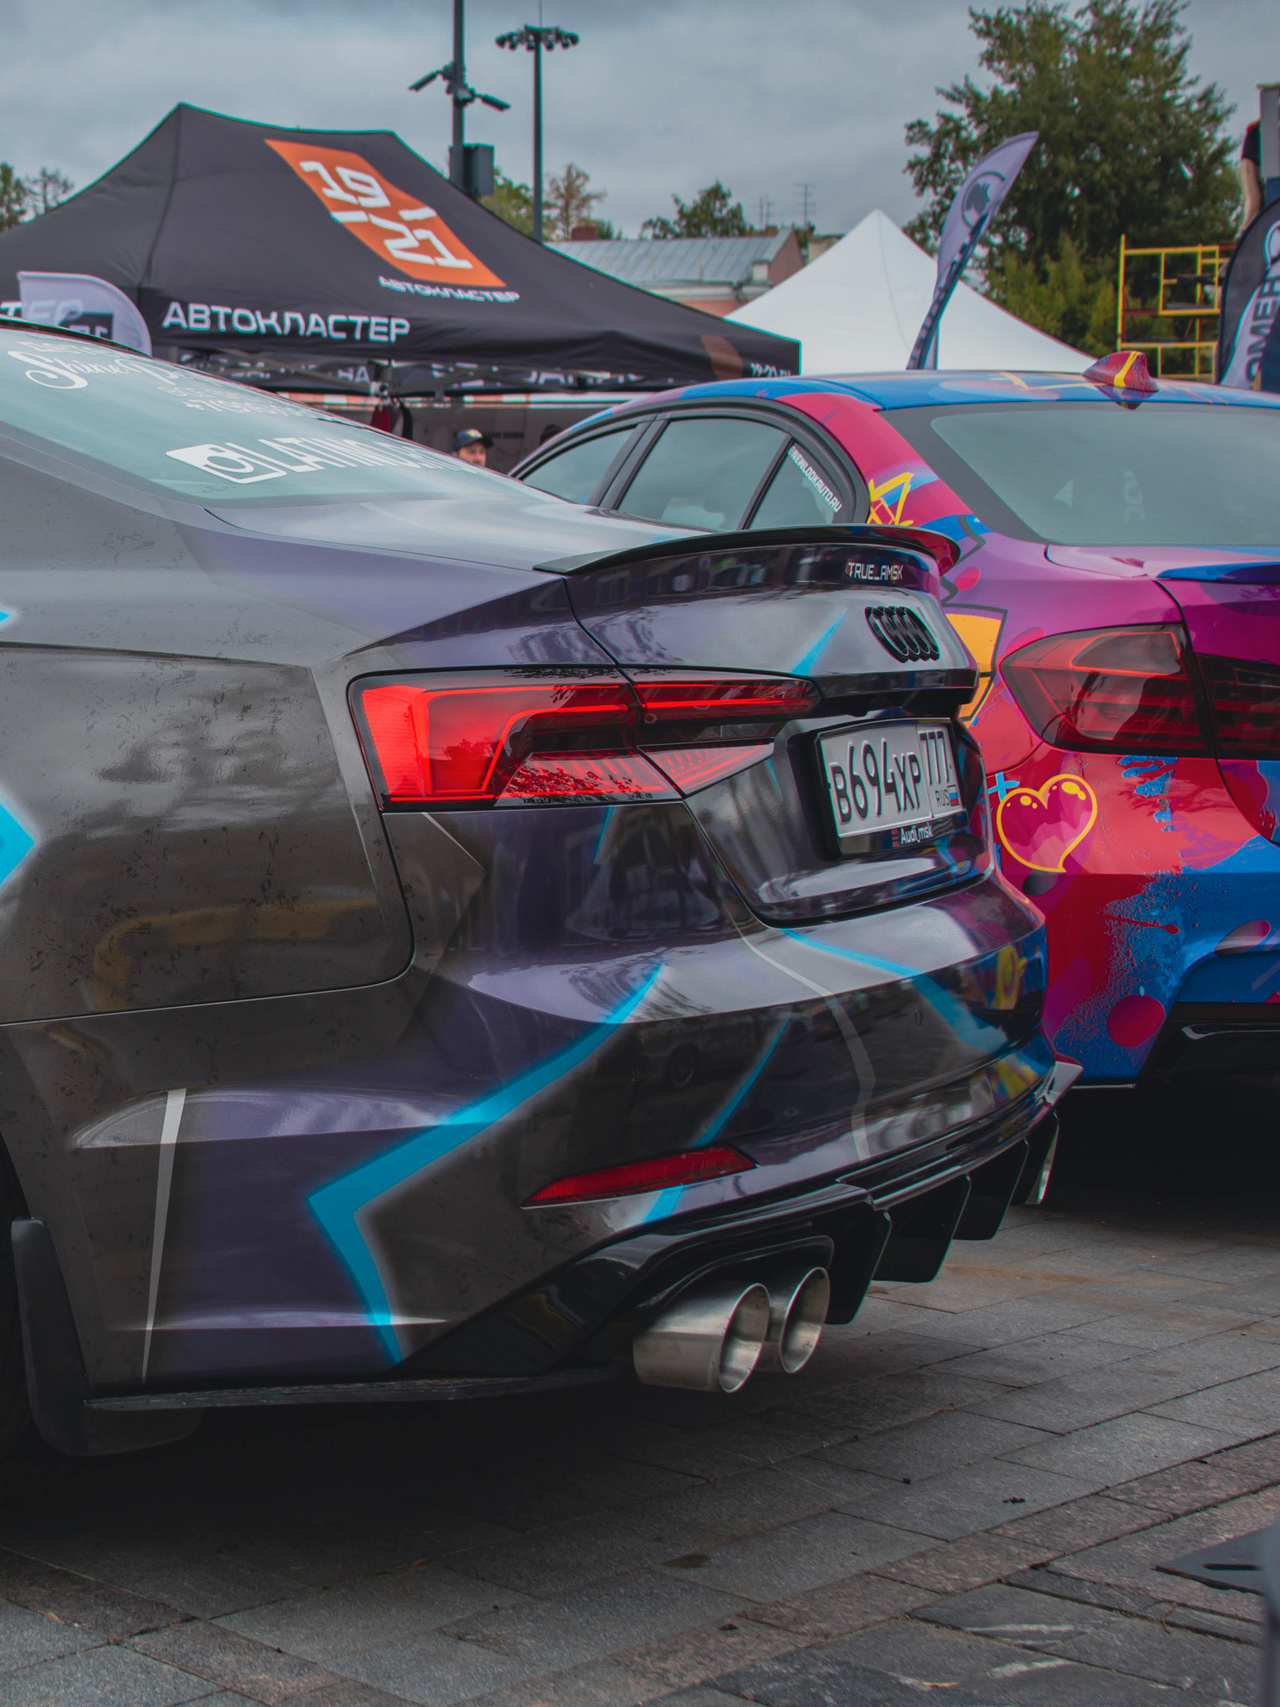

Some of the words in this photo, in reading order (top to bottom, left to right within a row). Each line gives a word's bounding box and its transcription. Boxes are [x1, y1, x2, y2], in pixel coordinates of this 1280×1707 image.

[299, 161, 391, 208] 19
[378, 276, 520, 302] АВТОКЛАСТЕР
[162, 301, 410, 343] АВТОКЛАСТЕР
[918, 730, 950, 786] 777
[934, 790, 950, 807] RUS
